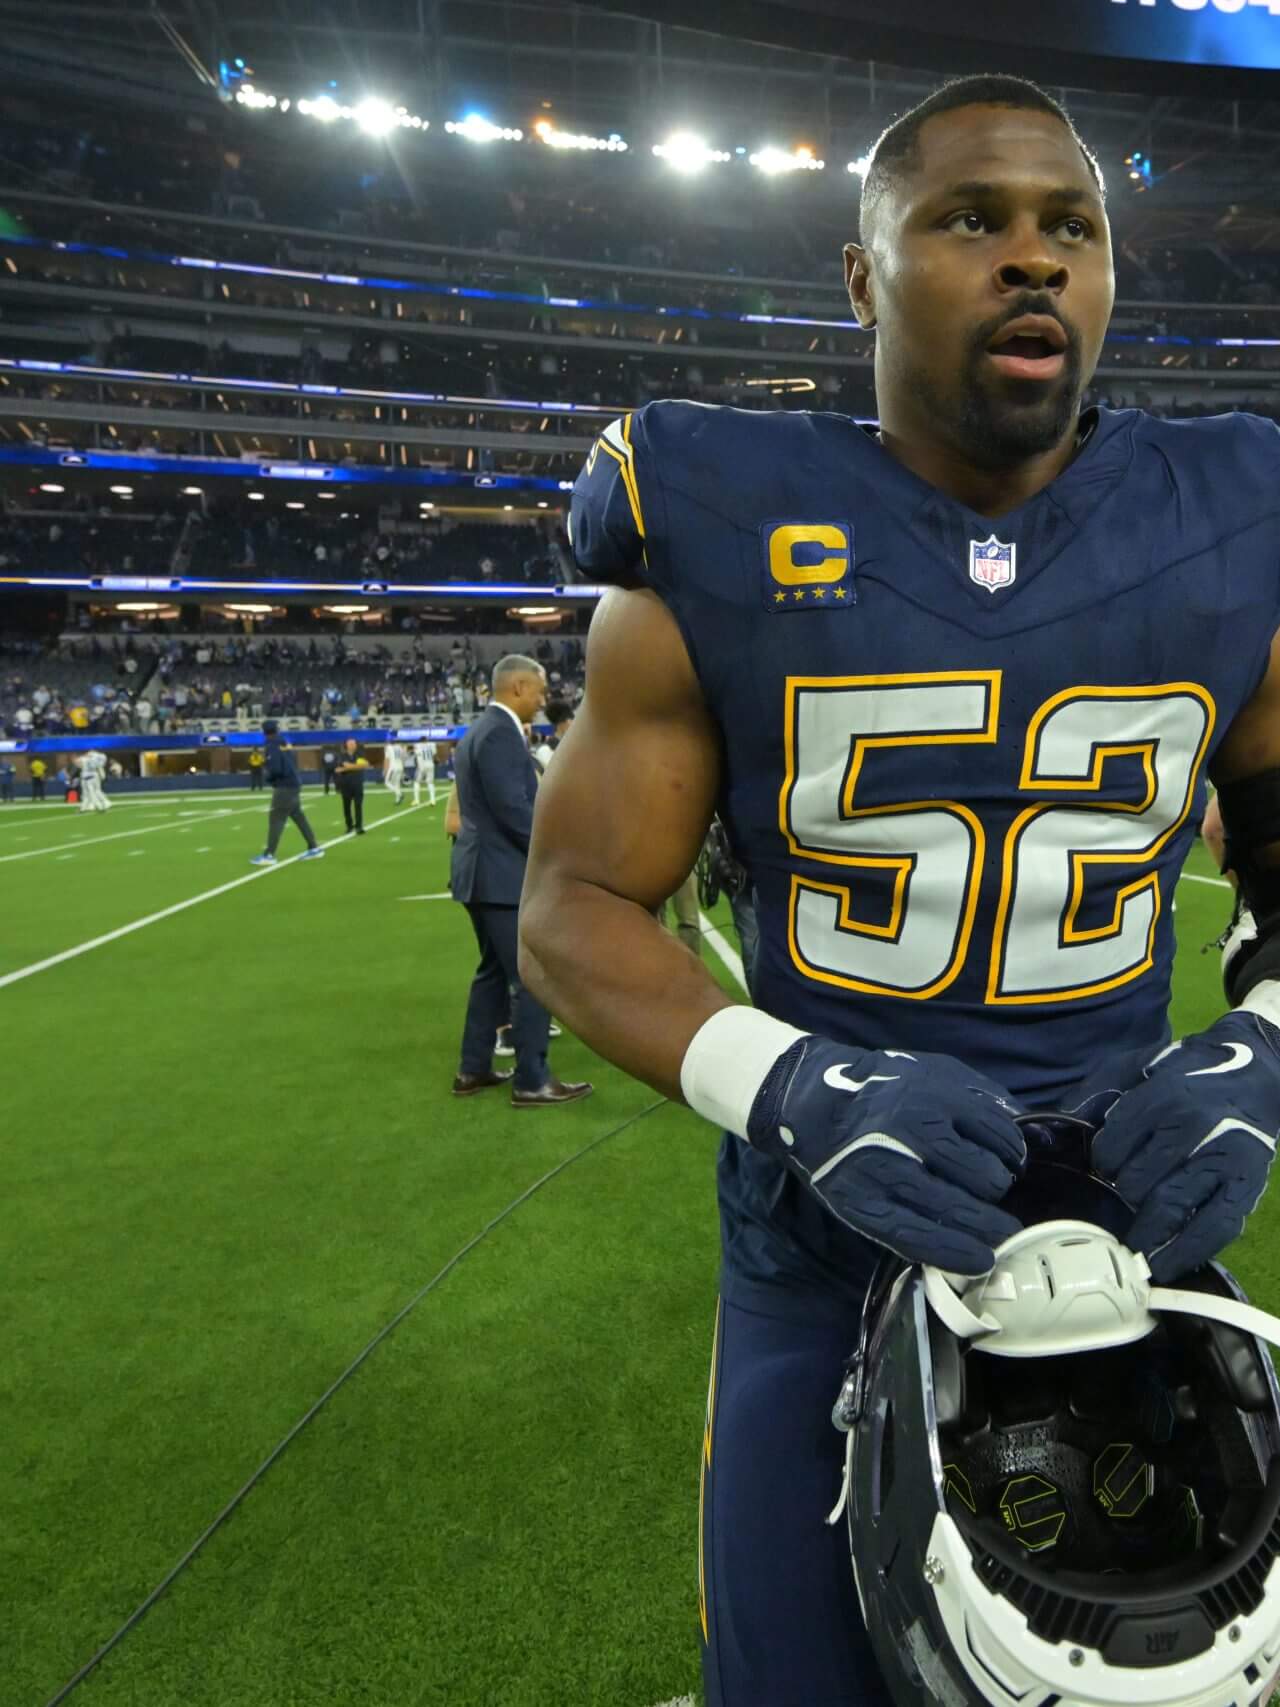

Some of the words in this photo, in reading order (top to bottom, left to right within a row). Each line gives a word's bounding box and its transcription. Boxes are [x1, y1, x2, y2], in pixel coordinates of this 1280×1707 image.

[769, 525, 847, 586] C
[975, 559, 1010, 582] NFL
[778, 669, 1217, 1005] 52
